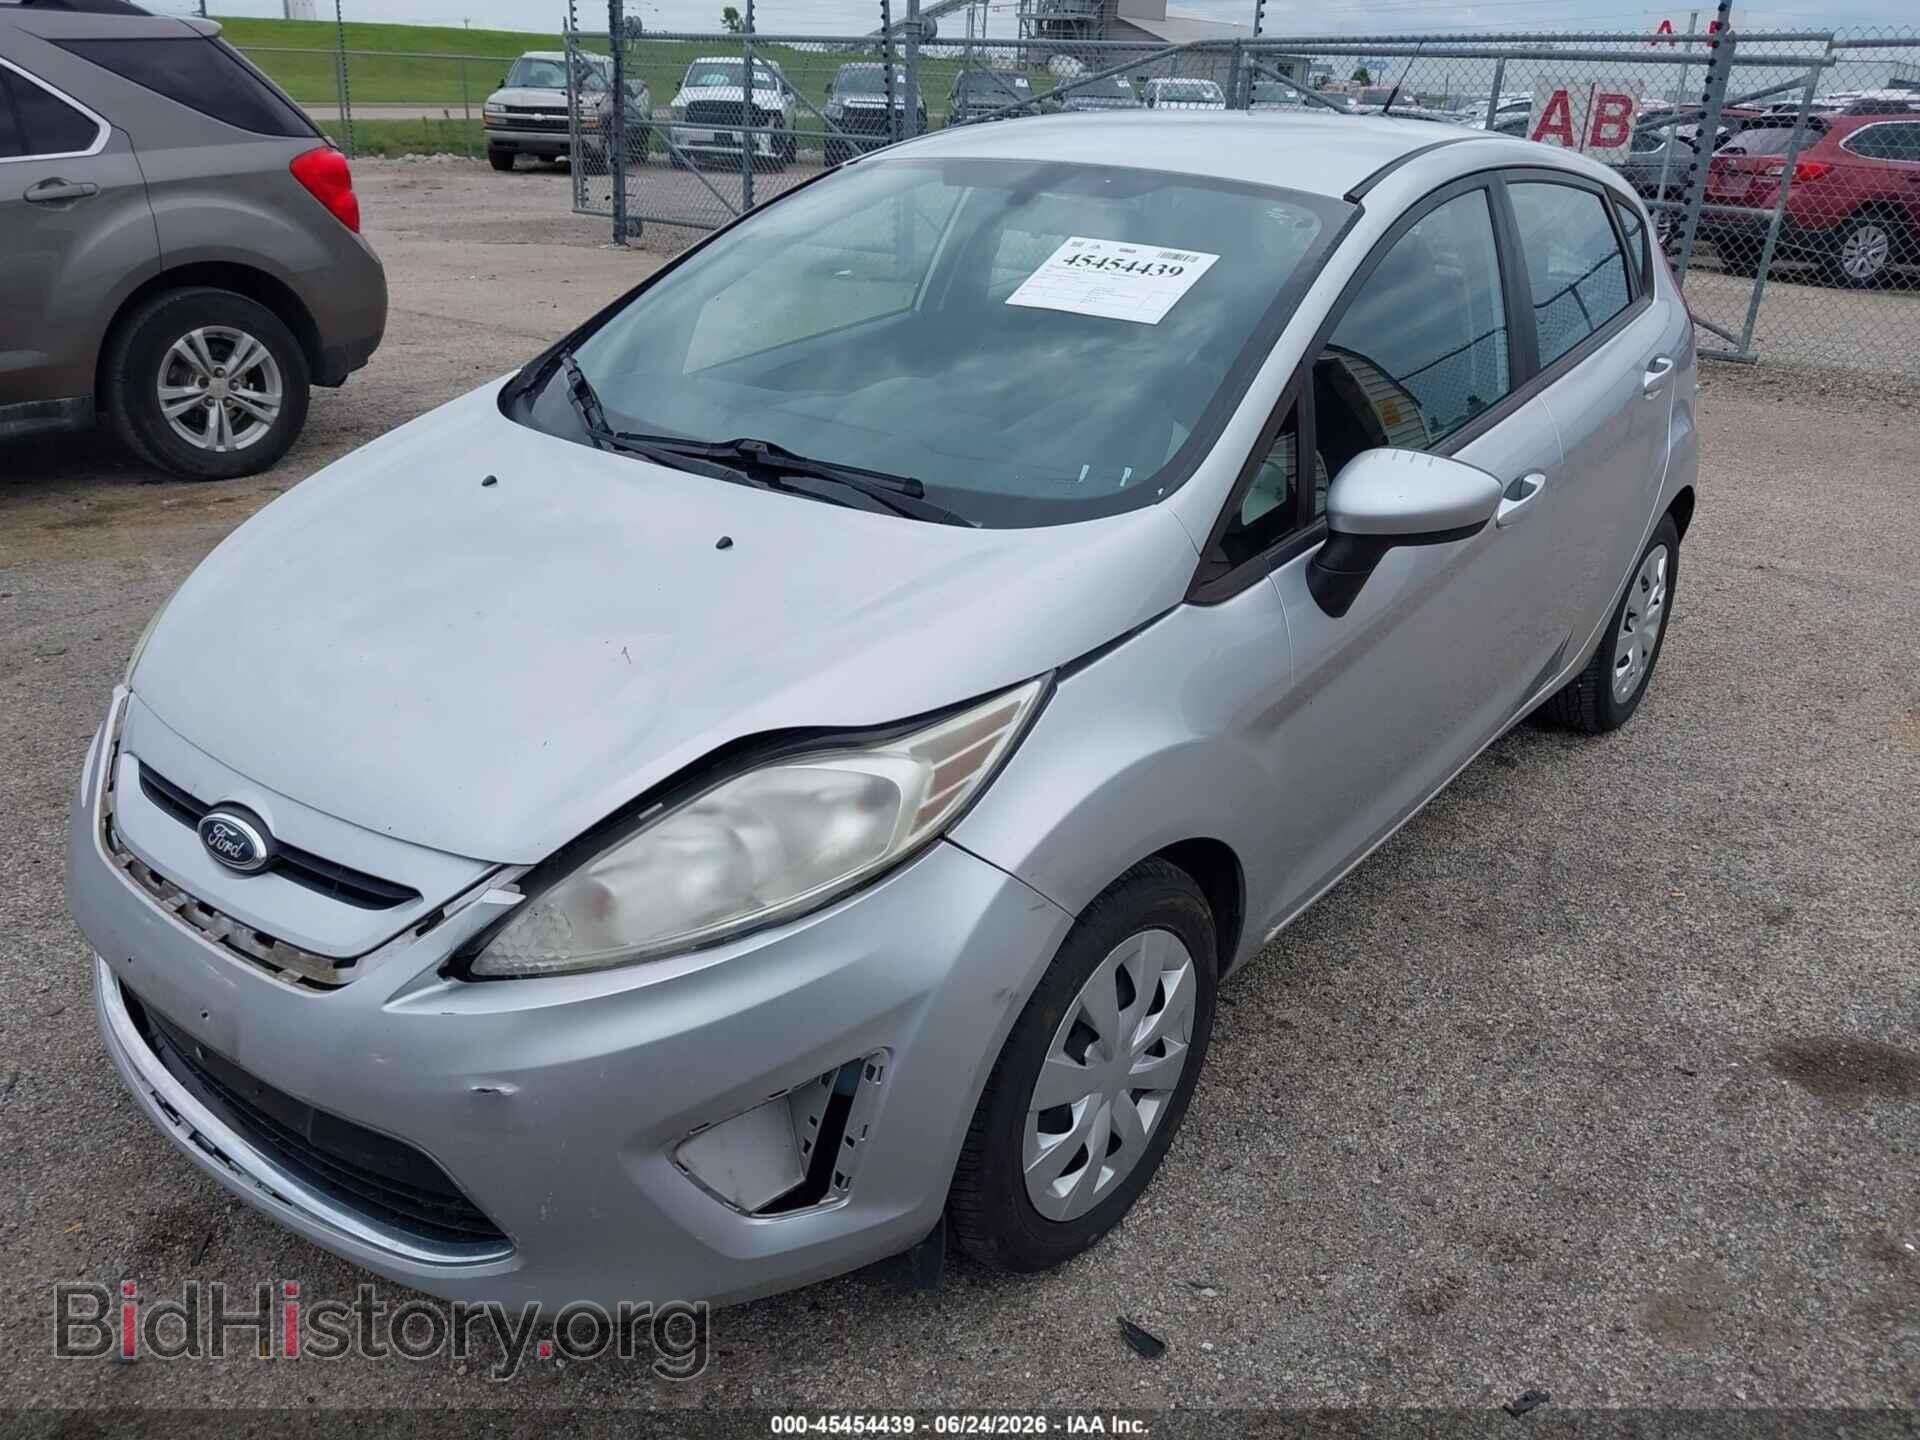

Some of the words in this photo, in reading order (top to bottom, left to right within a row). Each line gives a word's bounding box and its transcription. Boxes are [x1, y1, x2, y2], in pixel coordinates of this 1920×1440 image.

[1531, 90, 1573, 147] A
[1589, 93, 1633, 148] B
[1063, 254, 1184, 277] 45454439
[208, 823, 246, 858] Ford
